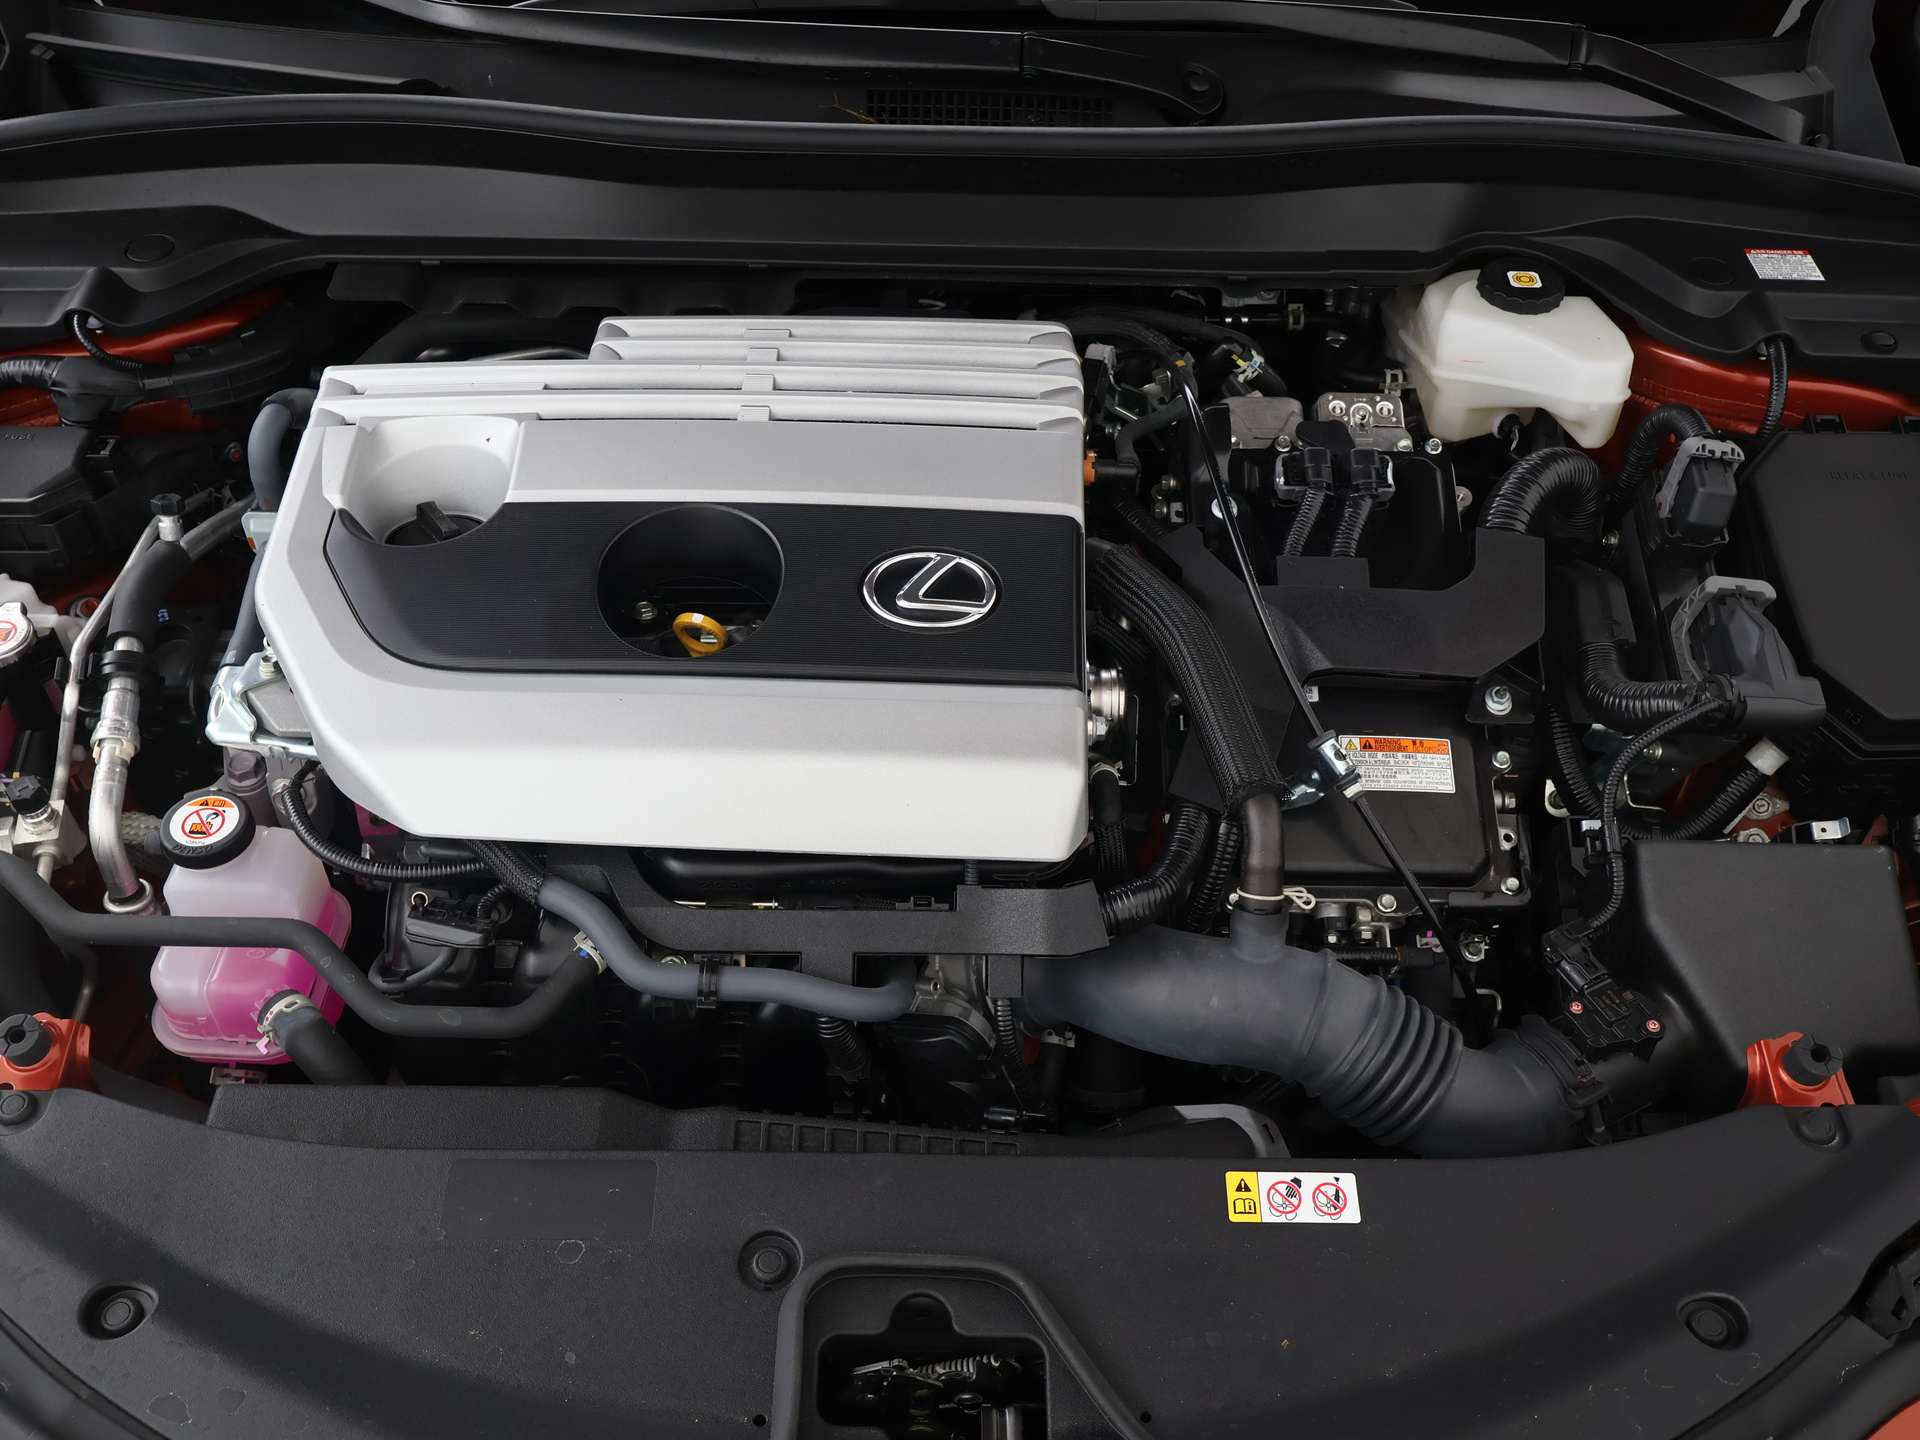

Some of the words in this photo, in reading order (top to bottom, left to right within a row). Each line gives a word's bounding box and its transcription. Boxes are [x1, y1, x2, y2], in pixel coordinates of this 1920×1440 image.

[1829, 471, 1866, 480] RELAY
[1881, 471, 1912, 480] FUSE
[1374, 744, 1408, 752] AVERTISSEMENT
[171, 844, 213, 855] DENSO
